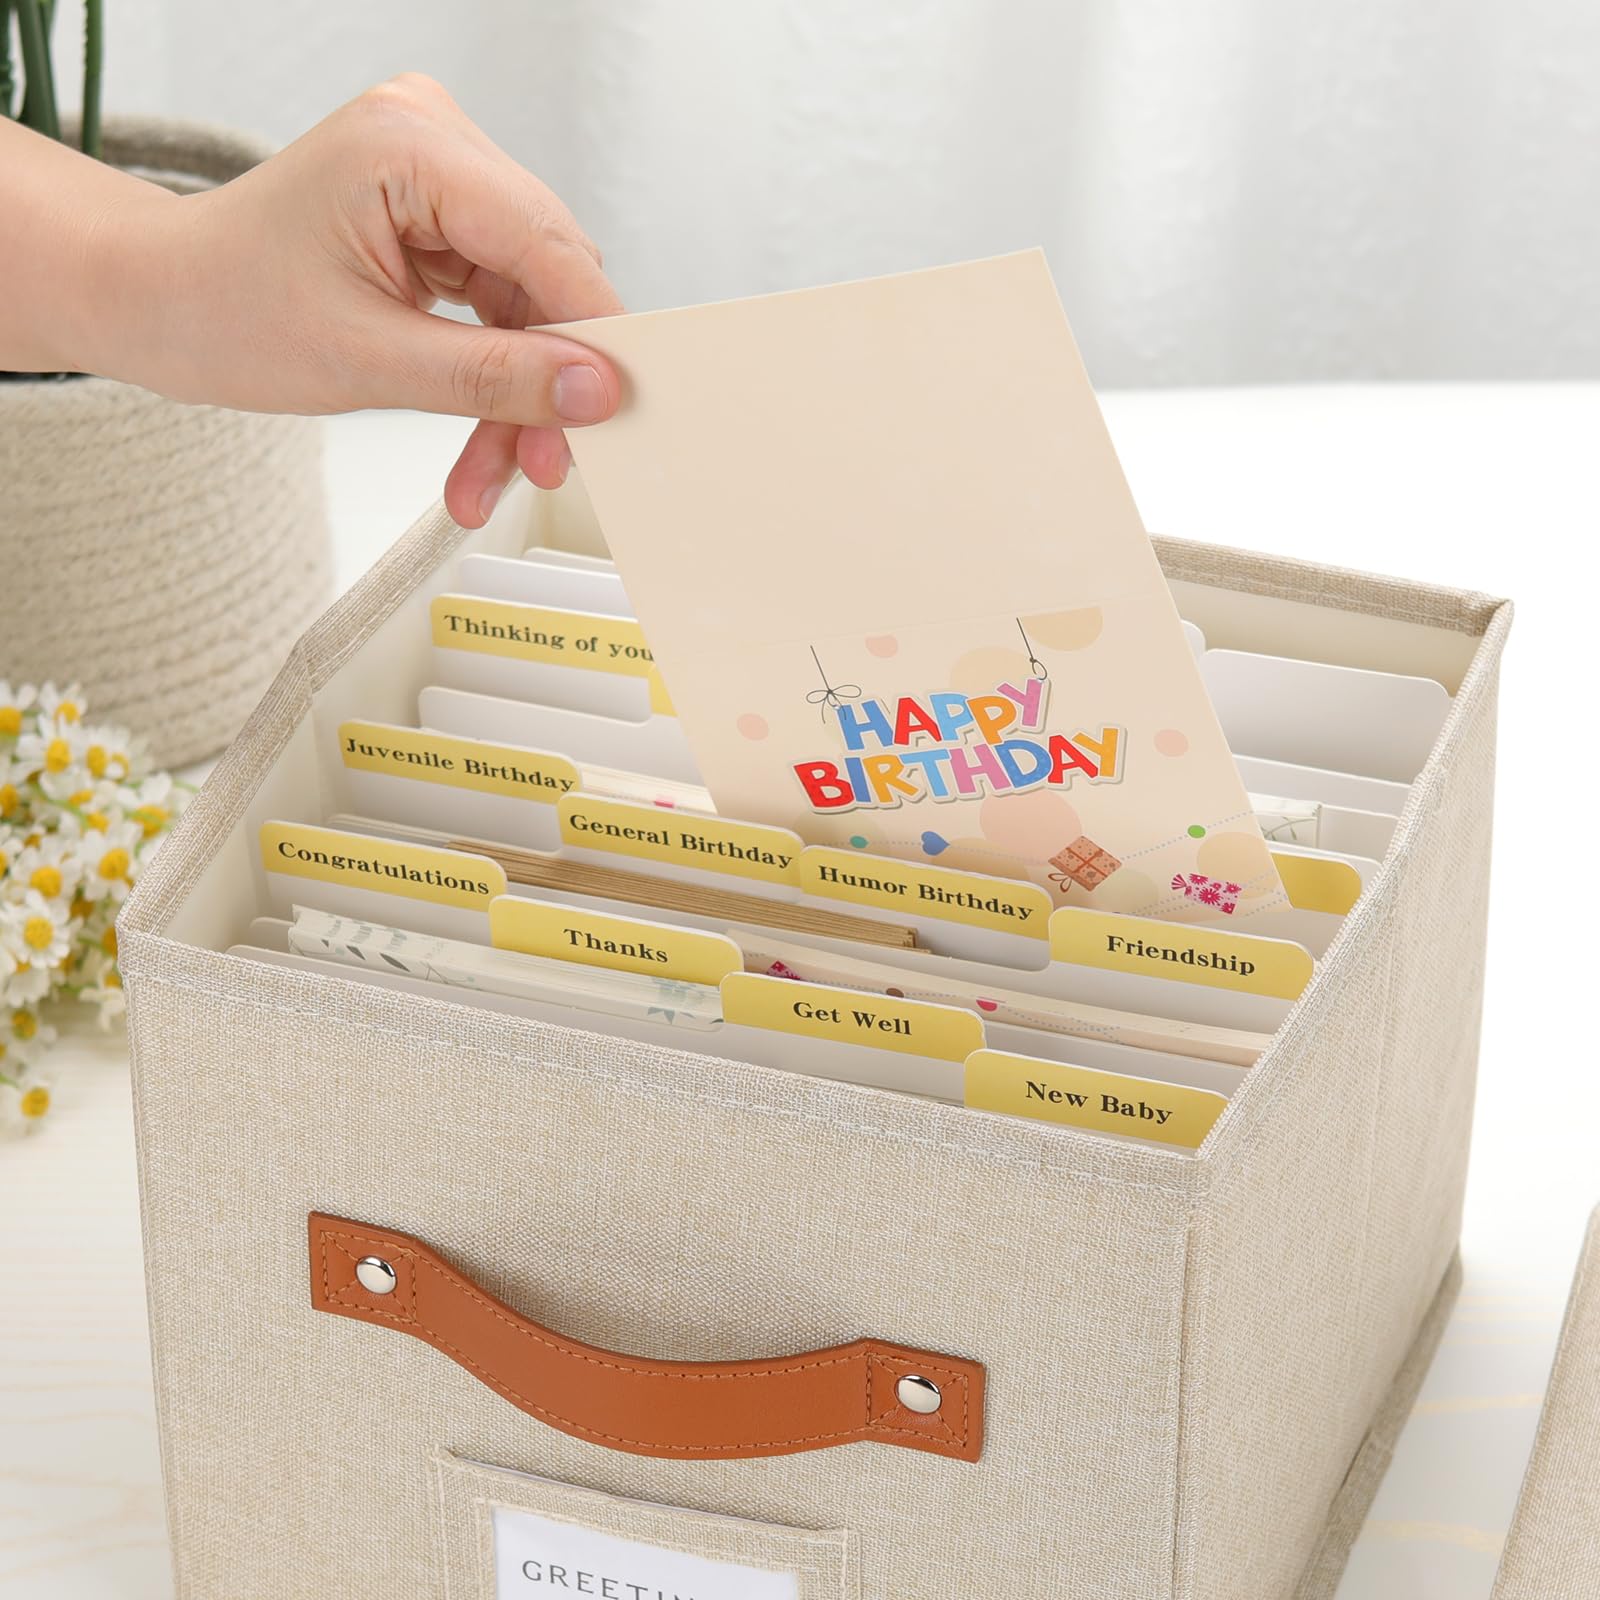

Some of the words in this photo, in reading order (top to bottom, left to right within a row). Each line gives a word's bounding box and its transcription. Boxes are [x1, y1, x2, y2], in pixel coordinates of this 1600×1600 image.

[443, 614, 566, 650] Thinking
[575, 636, 599, 653] of
[608, 642, 655, 662] you
[836, 676, 1050, 752] HAPPY
[346, 737, 455, 771] Juvenile
[463, 758, 574, 793] Birthday
[793, 727, 1121, 810] BIRTHDAY
[277, 840, 490, 895] Congratulations
[568, 813, 670, 847] General
[679, 832, 793, 870] Birthday
[818, 864, 908, 896] Humor
[917, 882, 1034, 922] Birthday
[563, 927, 669, 964] Thanks
[1106, 934, 1256, 976] Friendship
[792, 1000, 842, 1024] Get
[851, 1009, 912, 1036] Well
[1025, 1079, 1089, 1109] New
[1100, 1092, 1174, 1125] Baby
